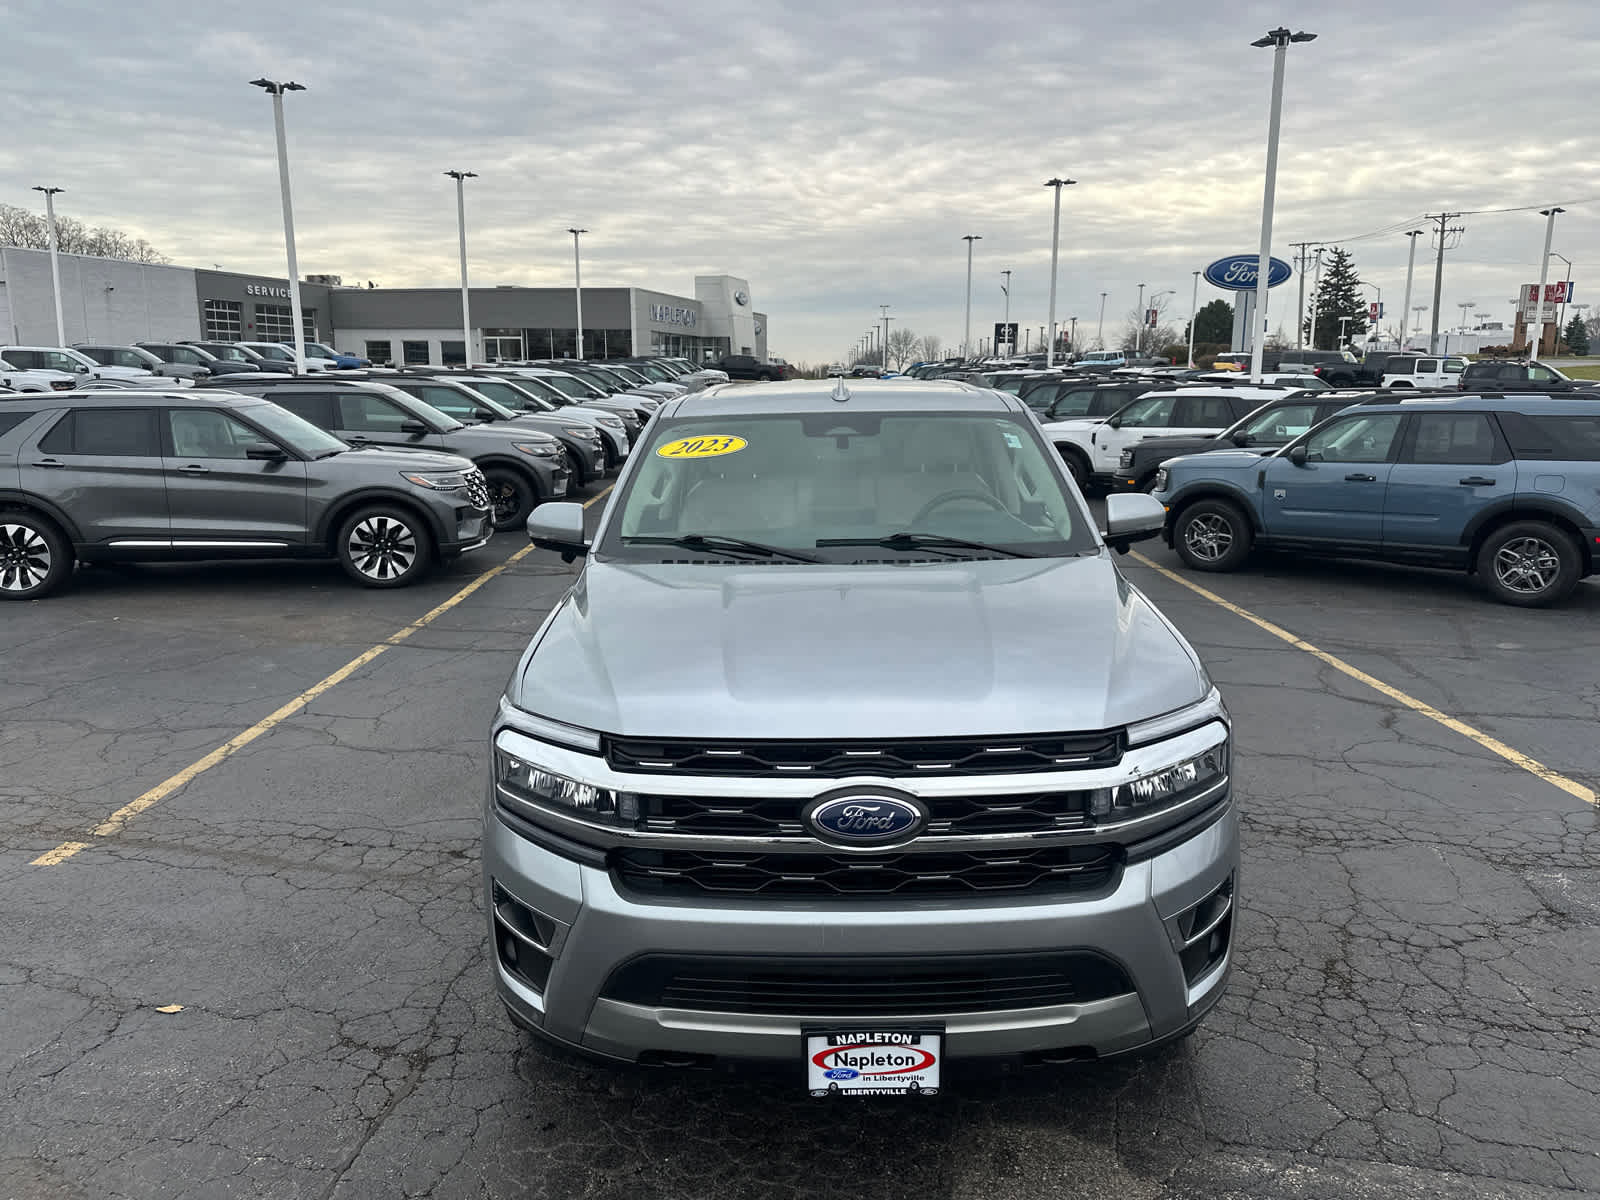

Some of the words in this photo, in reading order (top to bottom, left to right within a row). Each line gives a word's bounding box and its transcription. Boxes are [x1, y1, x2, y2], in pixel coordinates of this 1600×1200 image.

[247, 284, 293, 298] SERVICE
[649, 303, 696, 327] NAPLETON
[670, 438, 734, 455] 2023
[837, 805, 896, 830] Ford
[836, 1033, 913, 1045] NAPLETON
[834, 1052, 916, 1070] Napleton
